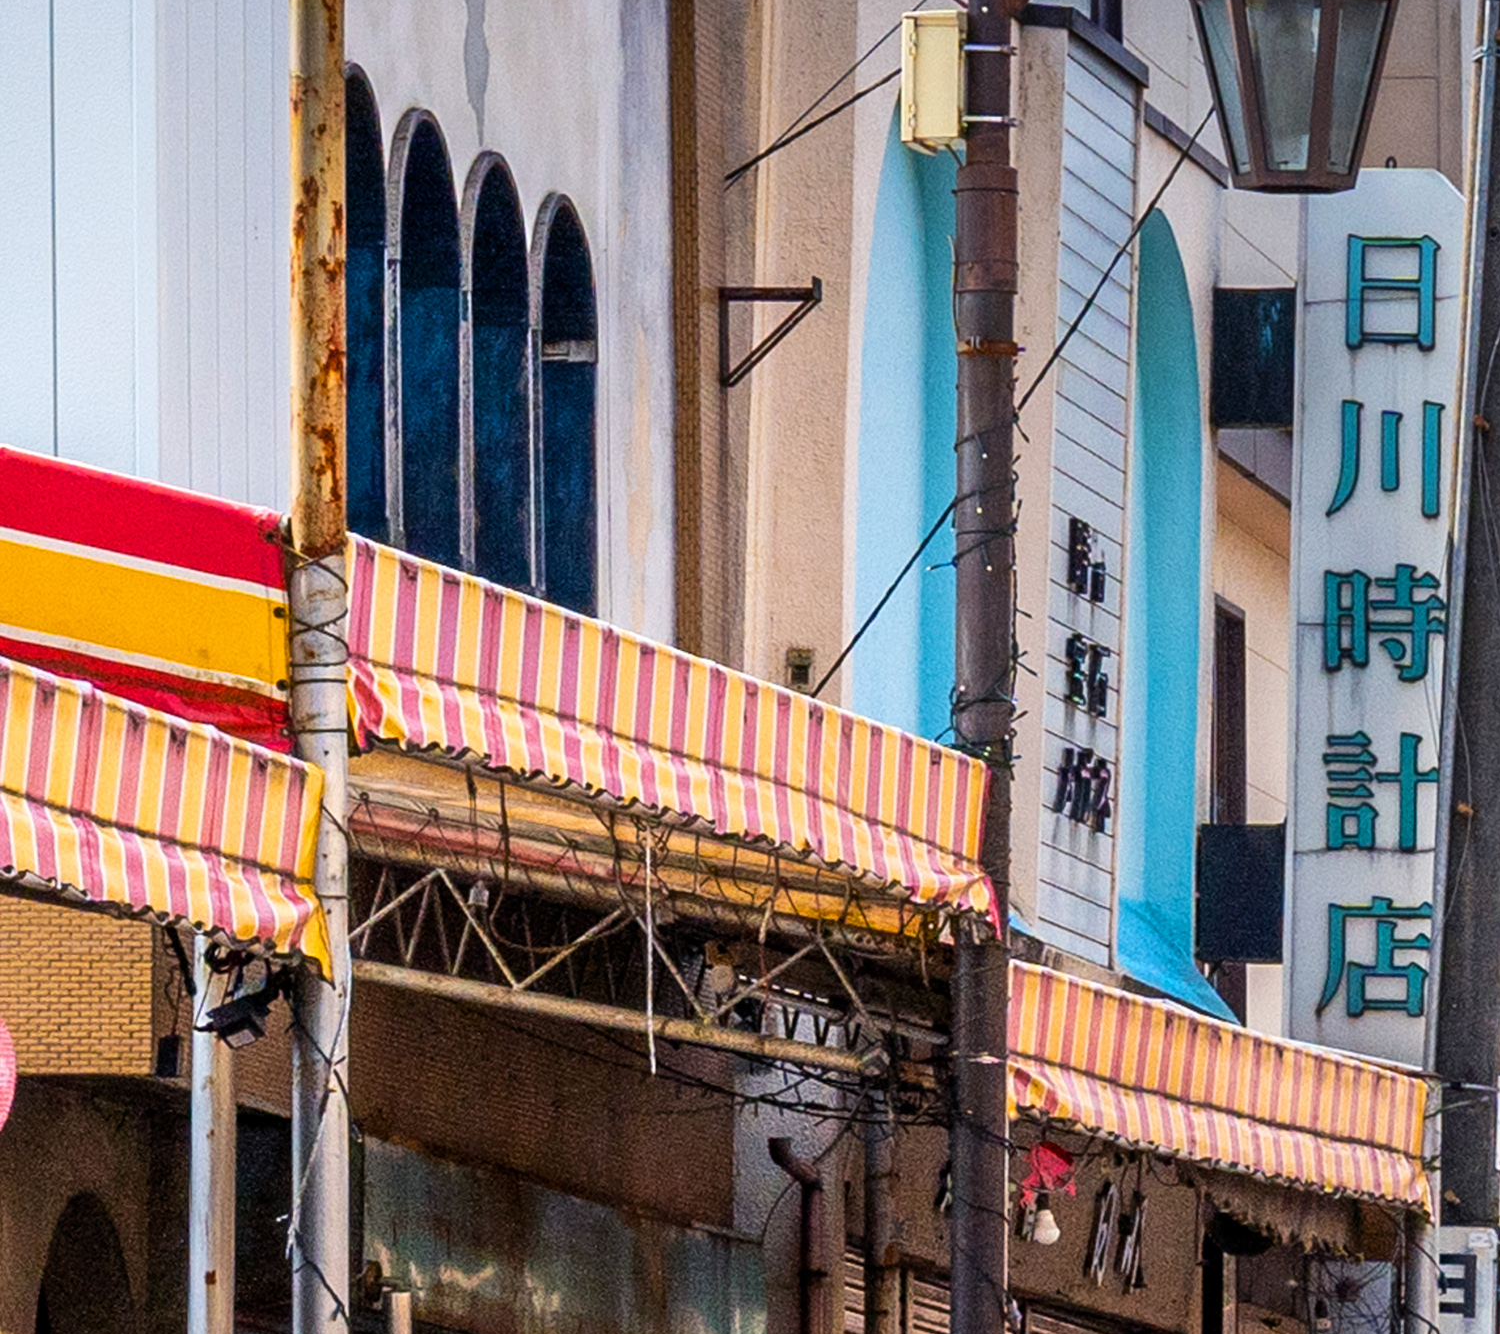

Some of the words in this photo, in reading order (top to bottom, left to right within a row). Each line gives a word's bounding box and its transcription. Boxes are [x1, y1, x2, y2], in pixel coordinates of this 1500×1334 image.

[1320, 233, 1446, 1021] 日川時計店
